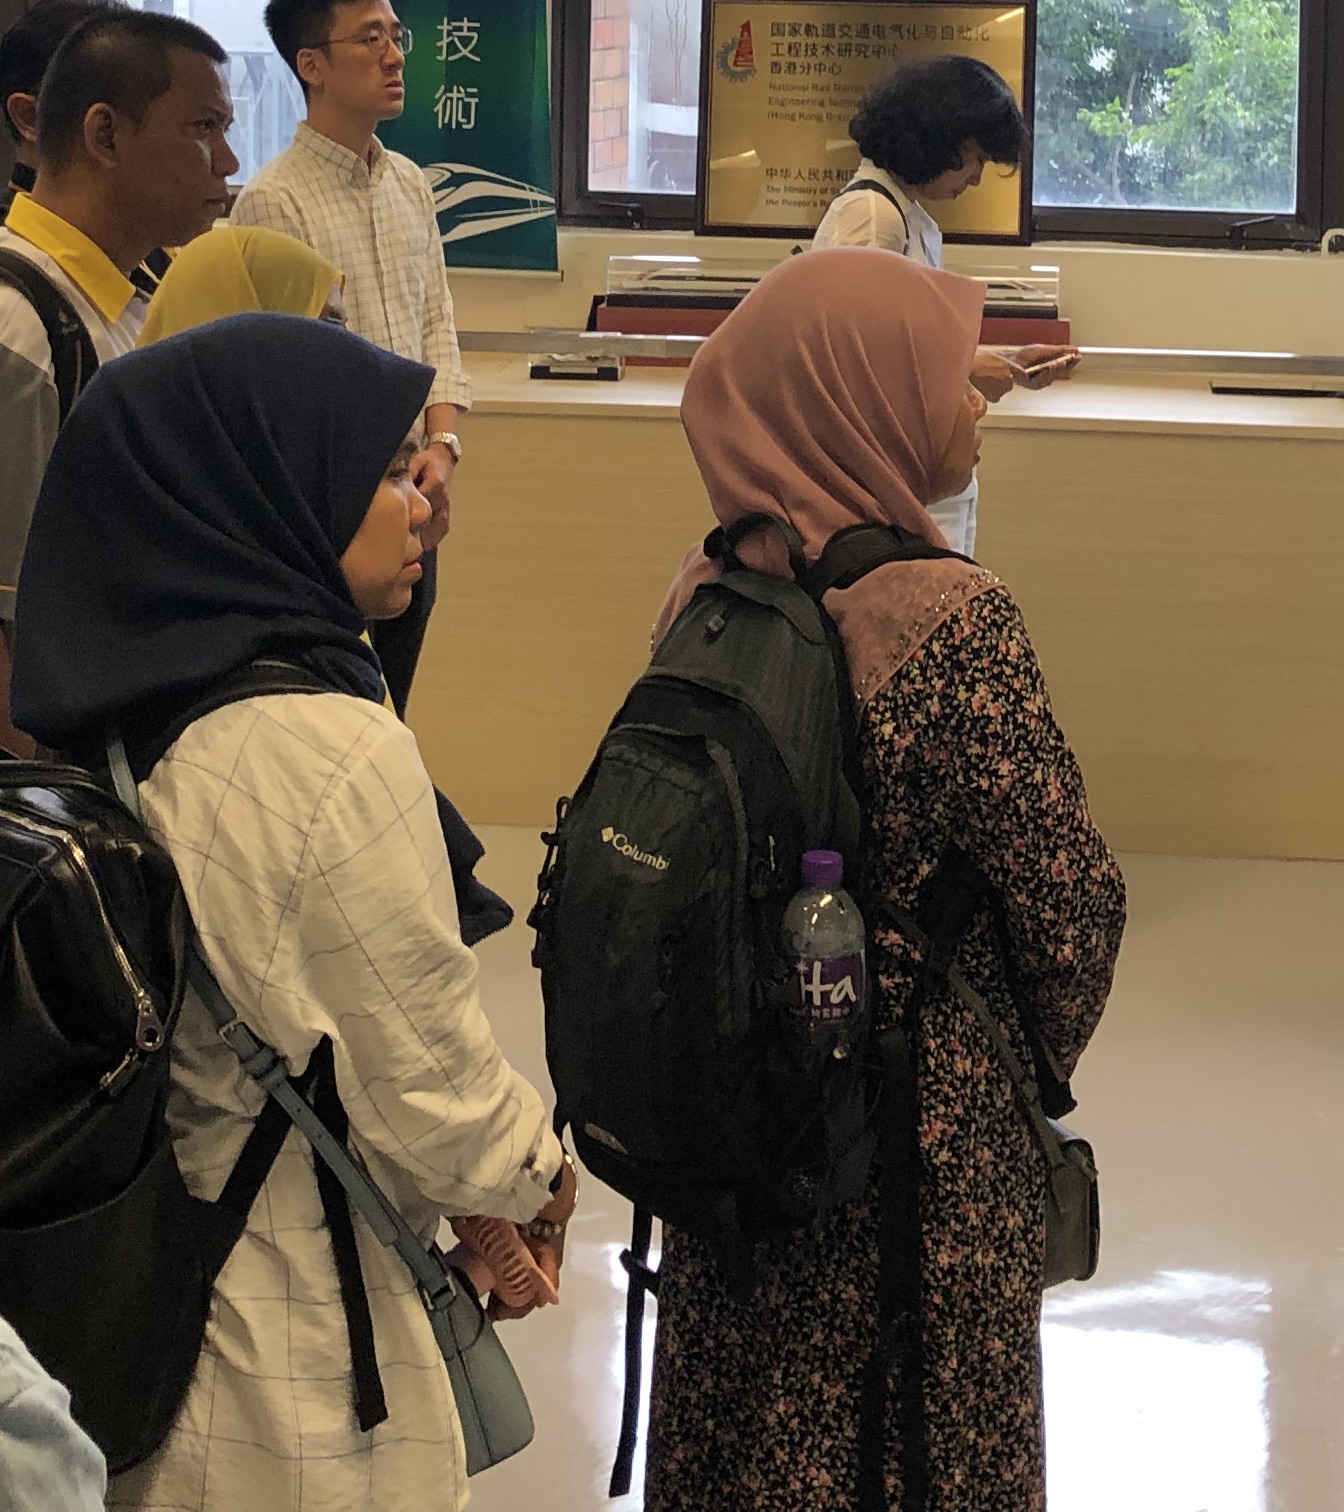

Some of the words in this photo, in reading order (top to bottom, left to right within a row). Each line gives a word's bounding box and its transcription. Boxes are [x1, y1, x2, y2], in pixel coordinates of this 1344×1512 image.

[770, 61, 842, 77] 香港分中心
